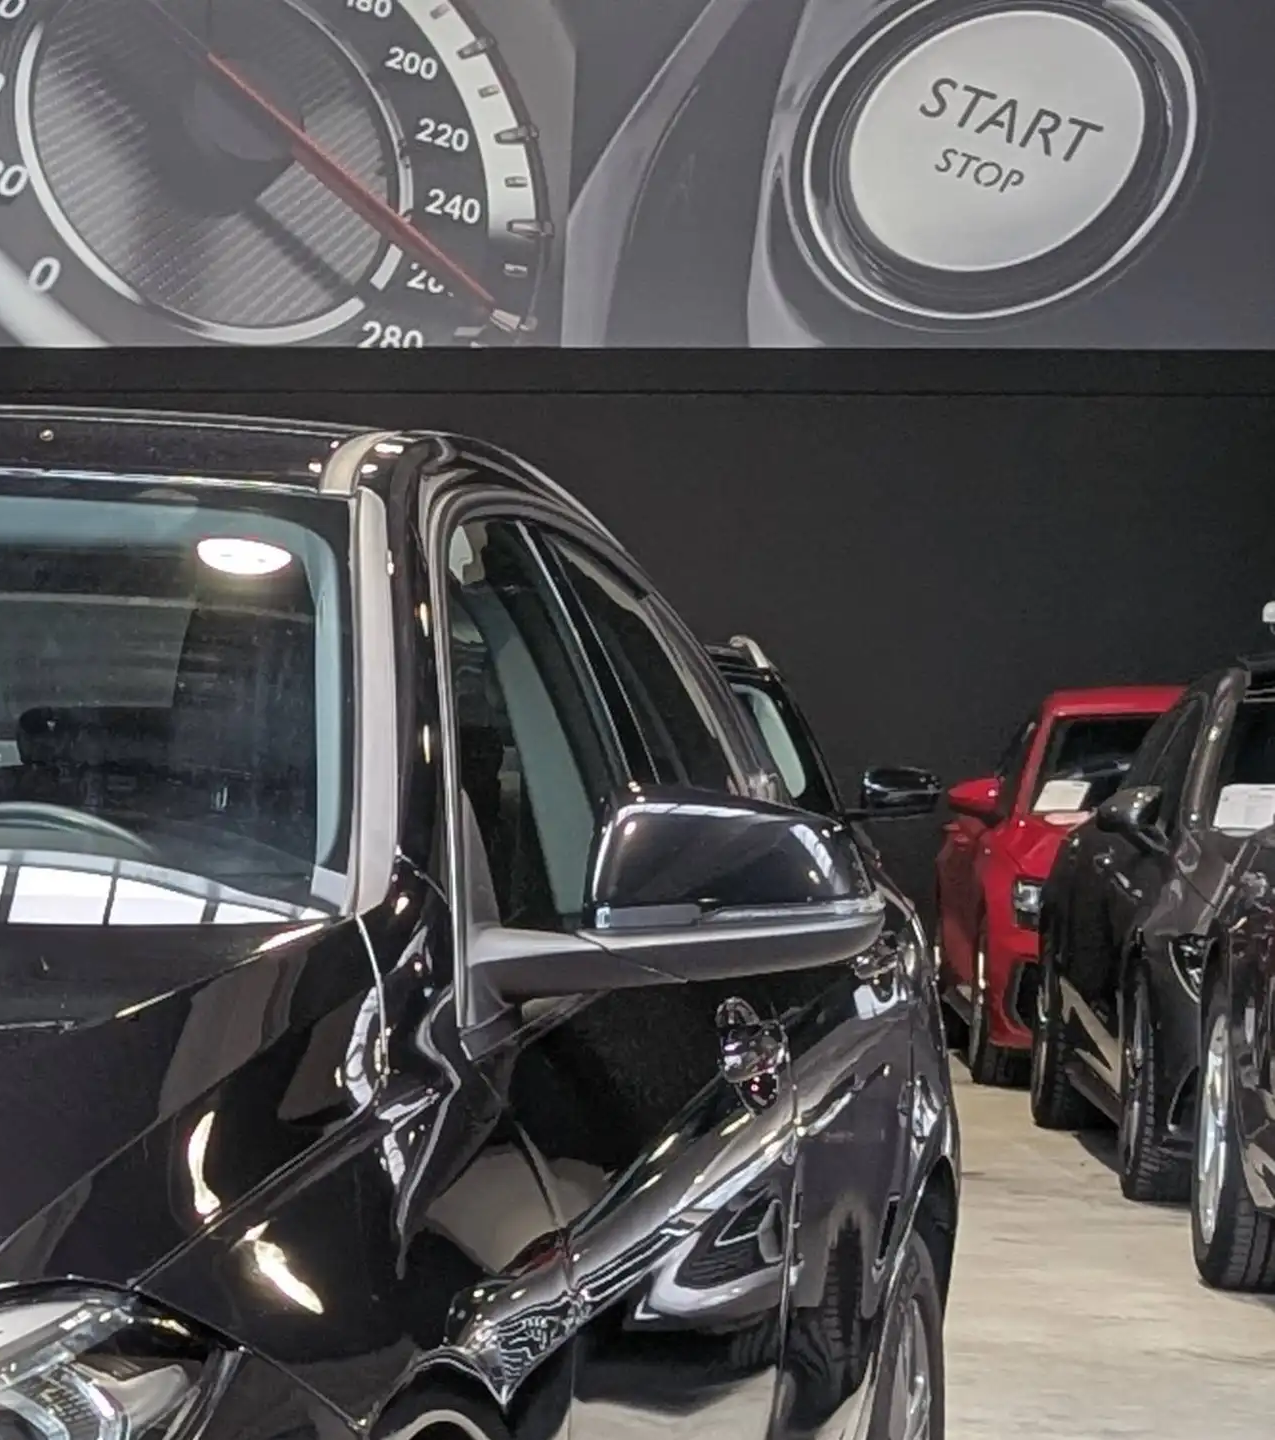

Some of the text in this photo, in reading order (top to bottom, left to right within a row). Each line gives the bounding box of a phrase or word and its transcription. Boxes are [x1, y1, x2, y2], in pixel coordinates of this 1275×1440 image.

[384, 46, 439, 80] 200
[414, 118, 469, 153] 220
[918, 77, 1105, 163] START
[934, 148, 1025, 194] STOP
[424, 188, 481, 224] 240
[28, 256, 62, 294] 0
